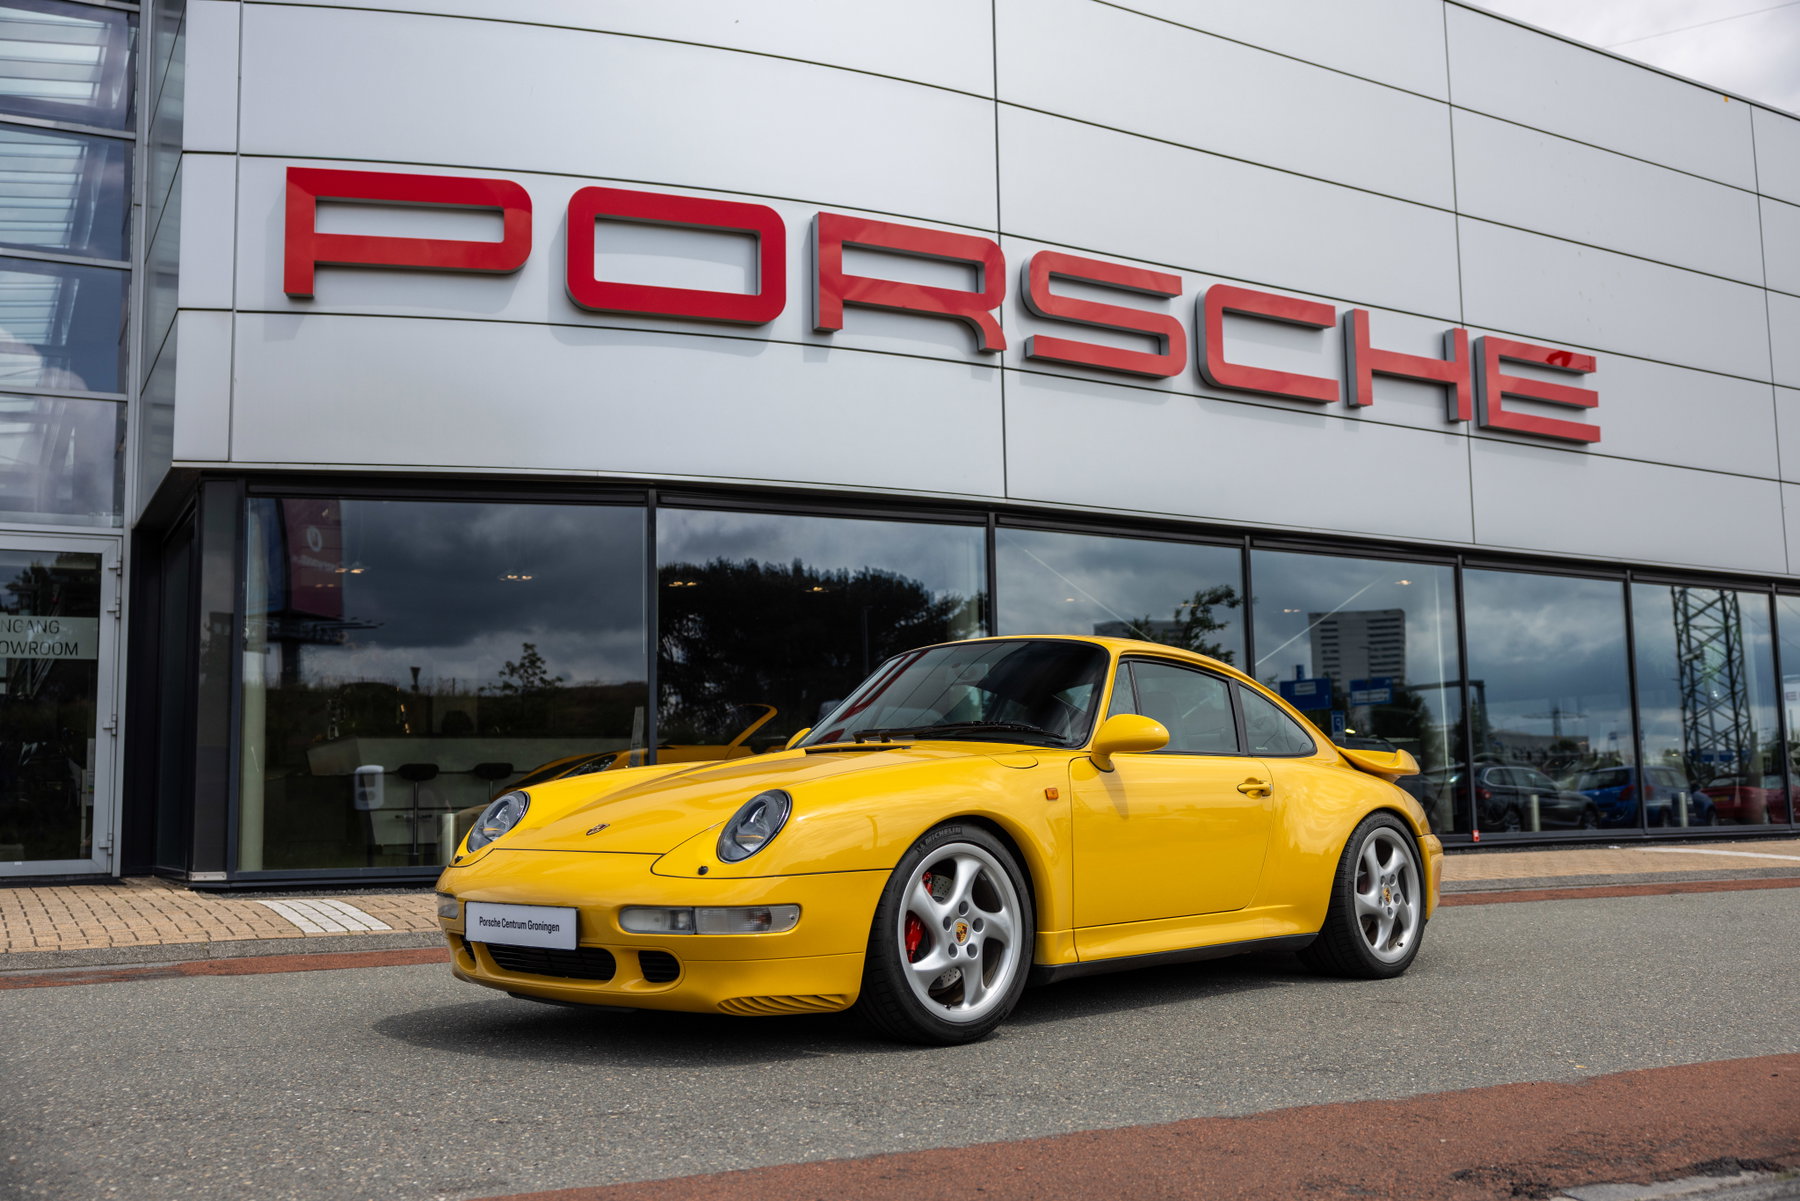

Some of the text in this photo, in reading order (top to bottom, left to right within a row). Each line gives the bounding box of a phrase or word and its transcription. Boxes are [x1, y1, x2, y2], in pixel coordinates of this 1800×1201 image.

[284, 167, 1601, 443] PORSCHE
[0, 619, 60, 634] NGANG
[925, 826, 961, 845] MICHELIN
[479, 916, 560, 934] Porsche Centrum Groningen
